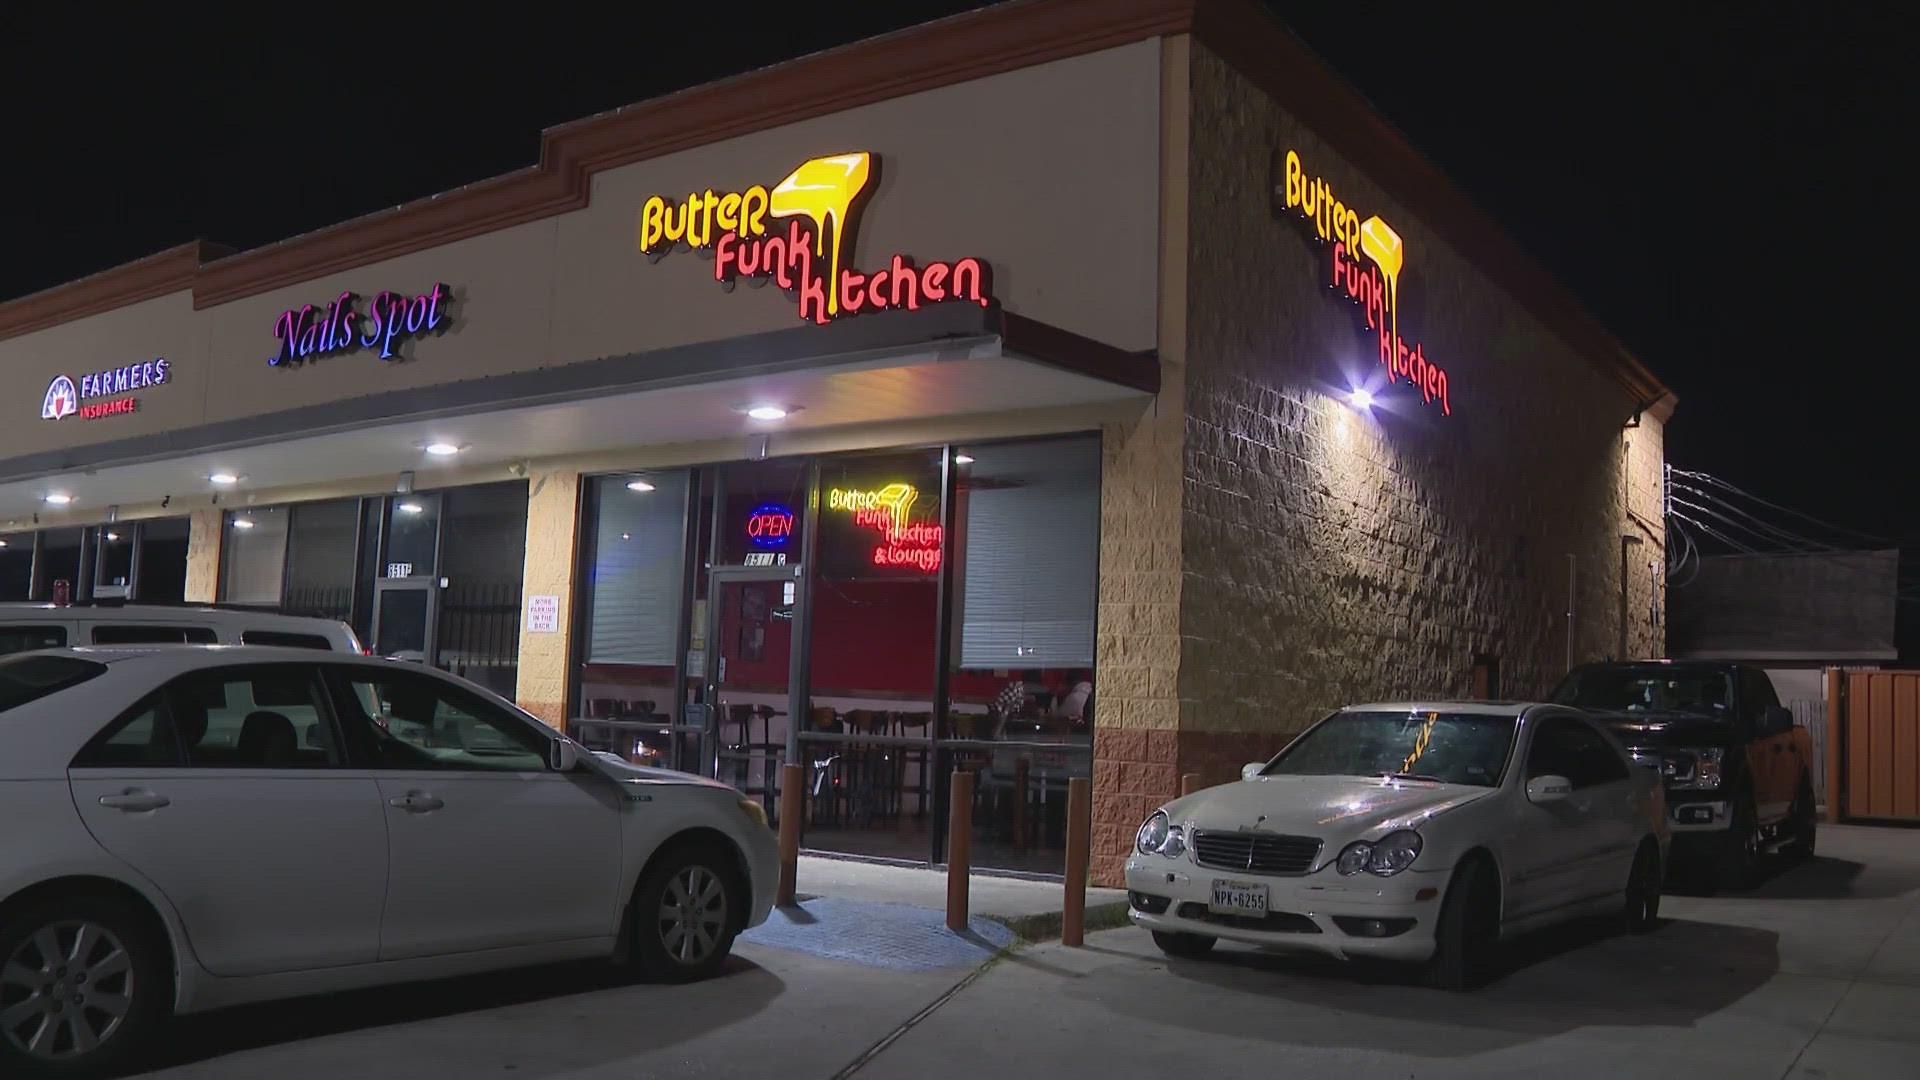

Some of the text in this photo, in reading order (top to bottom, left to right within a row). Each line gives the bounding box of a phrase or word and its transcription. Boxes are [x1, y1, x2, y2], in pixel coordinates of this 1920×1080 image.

[268, 283, 443, 367] Nails Spot
[79, 358, 167, 399] FARMERS
[79, 396, 135, 420] INSURANCE
[748, 513, 793, 538] OPEN
[530, 606, 556, 614] PARKING
